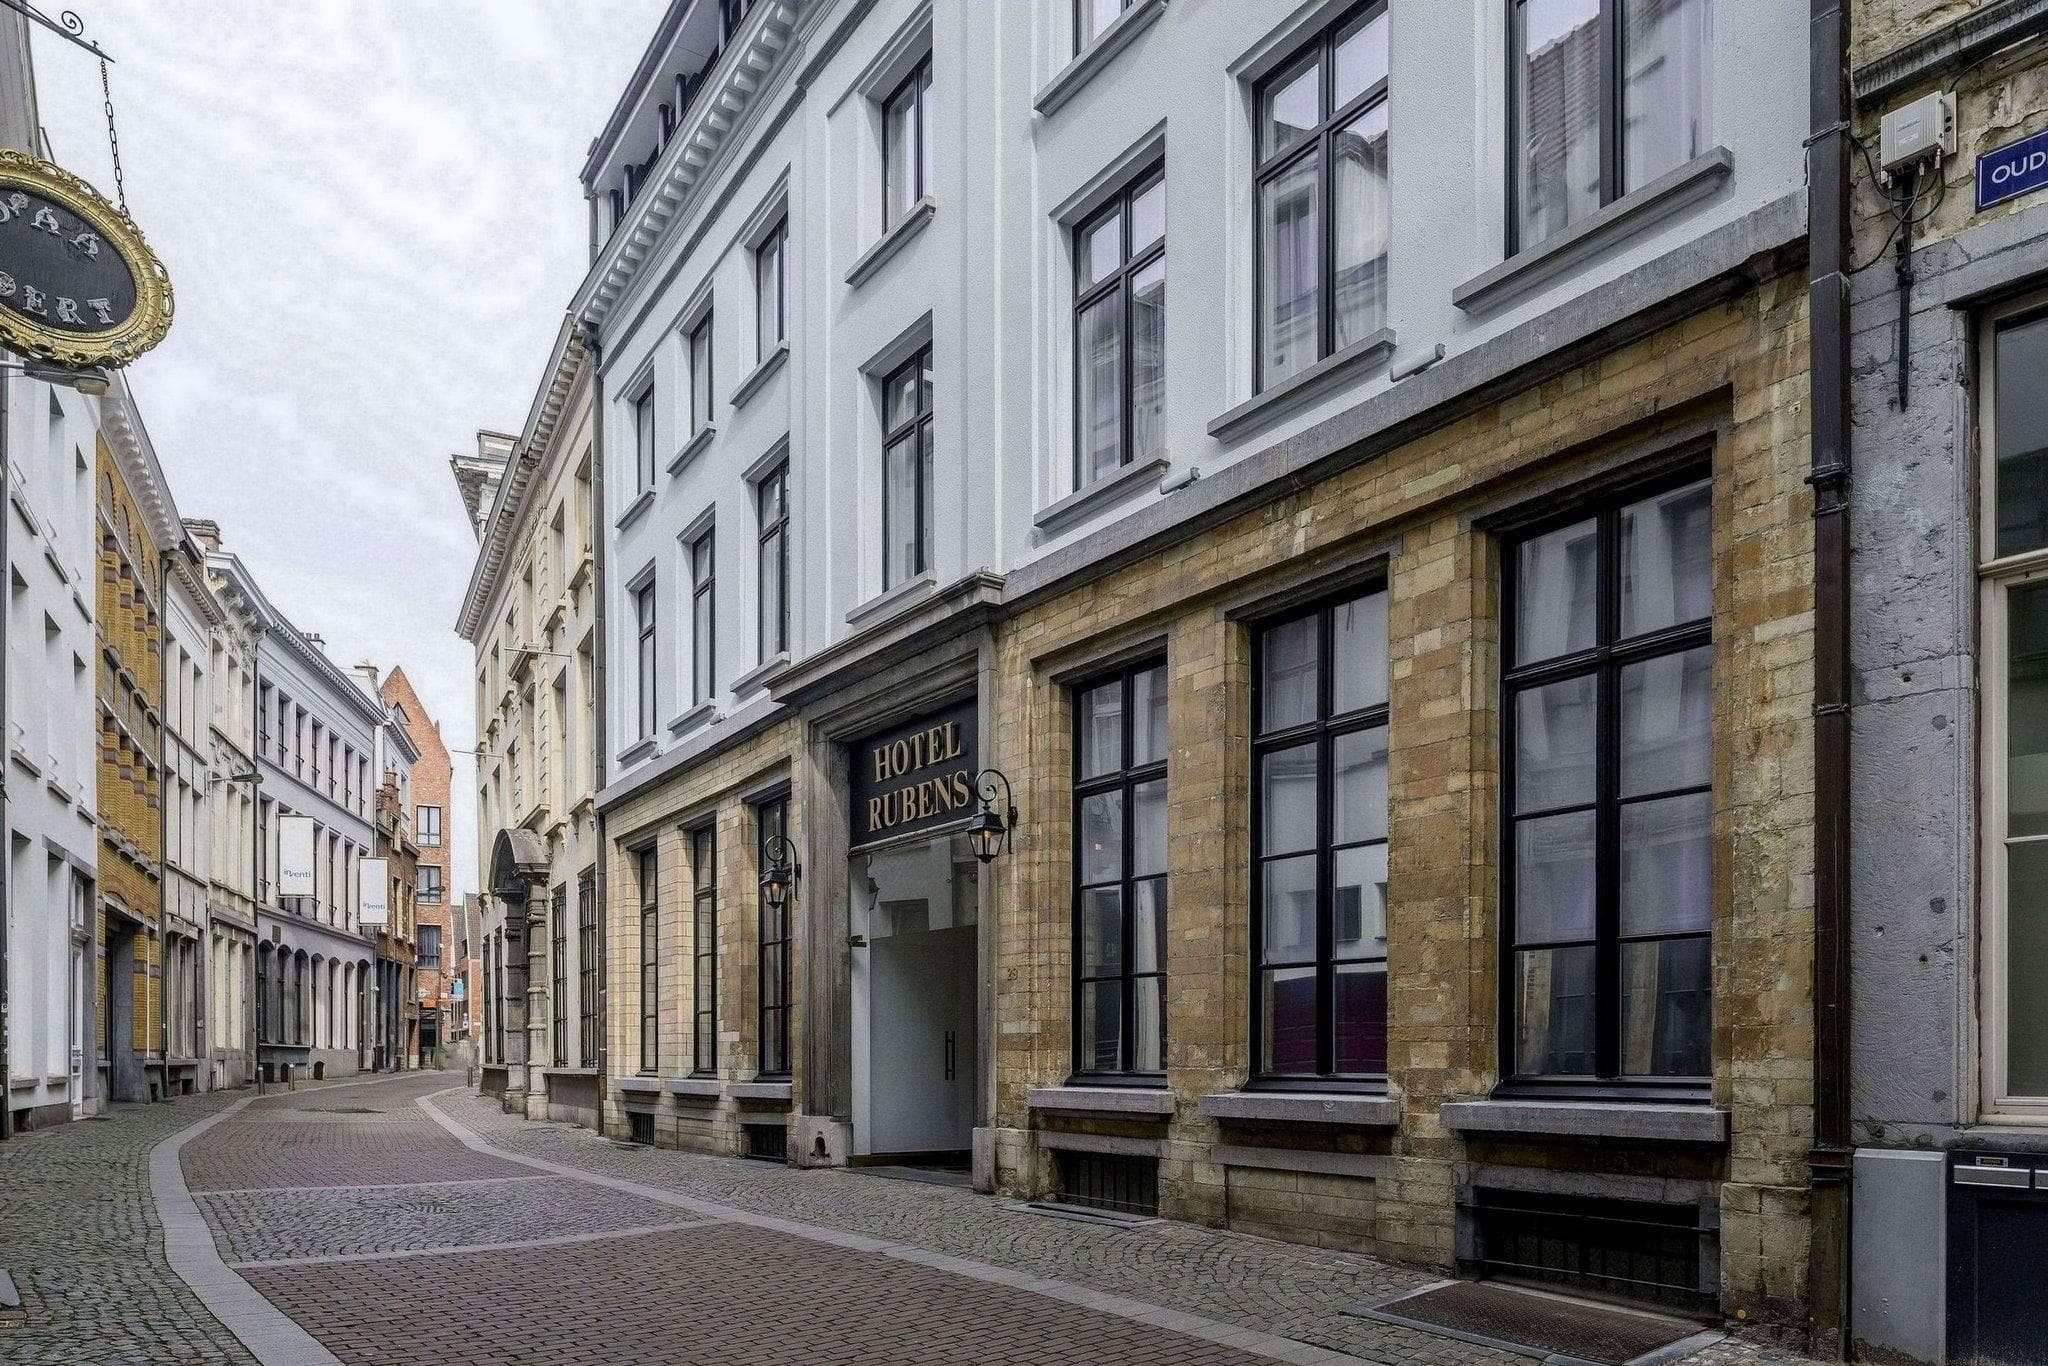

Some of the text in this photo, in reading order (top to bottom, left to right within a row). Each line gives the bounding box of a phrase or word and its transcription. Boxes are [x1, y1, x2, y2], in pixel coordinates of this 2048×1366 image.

[1991, 151, 2048, 184] OUD
[873, 721, 961, 783] HOTEL
[868, 769, 970, 832] RUBENS
